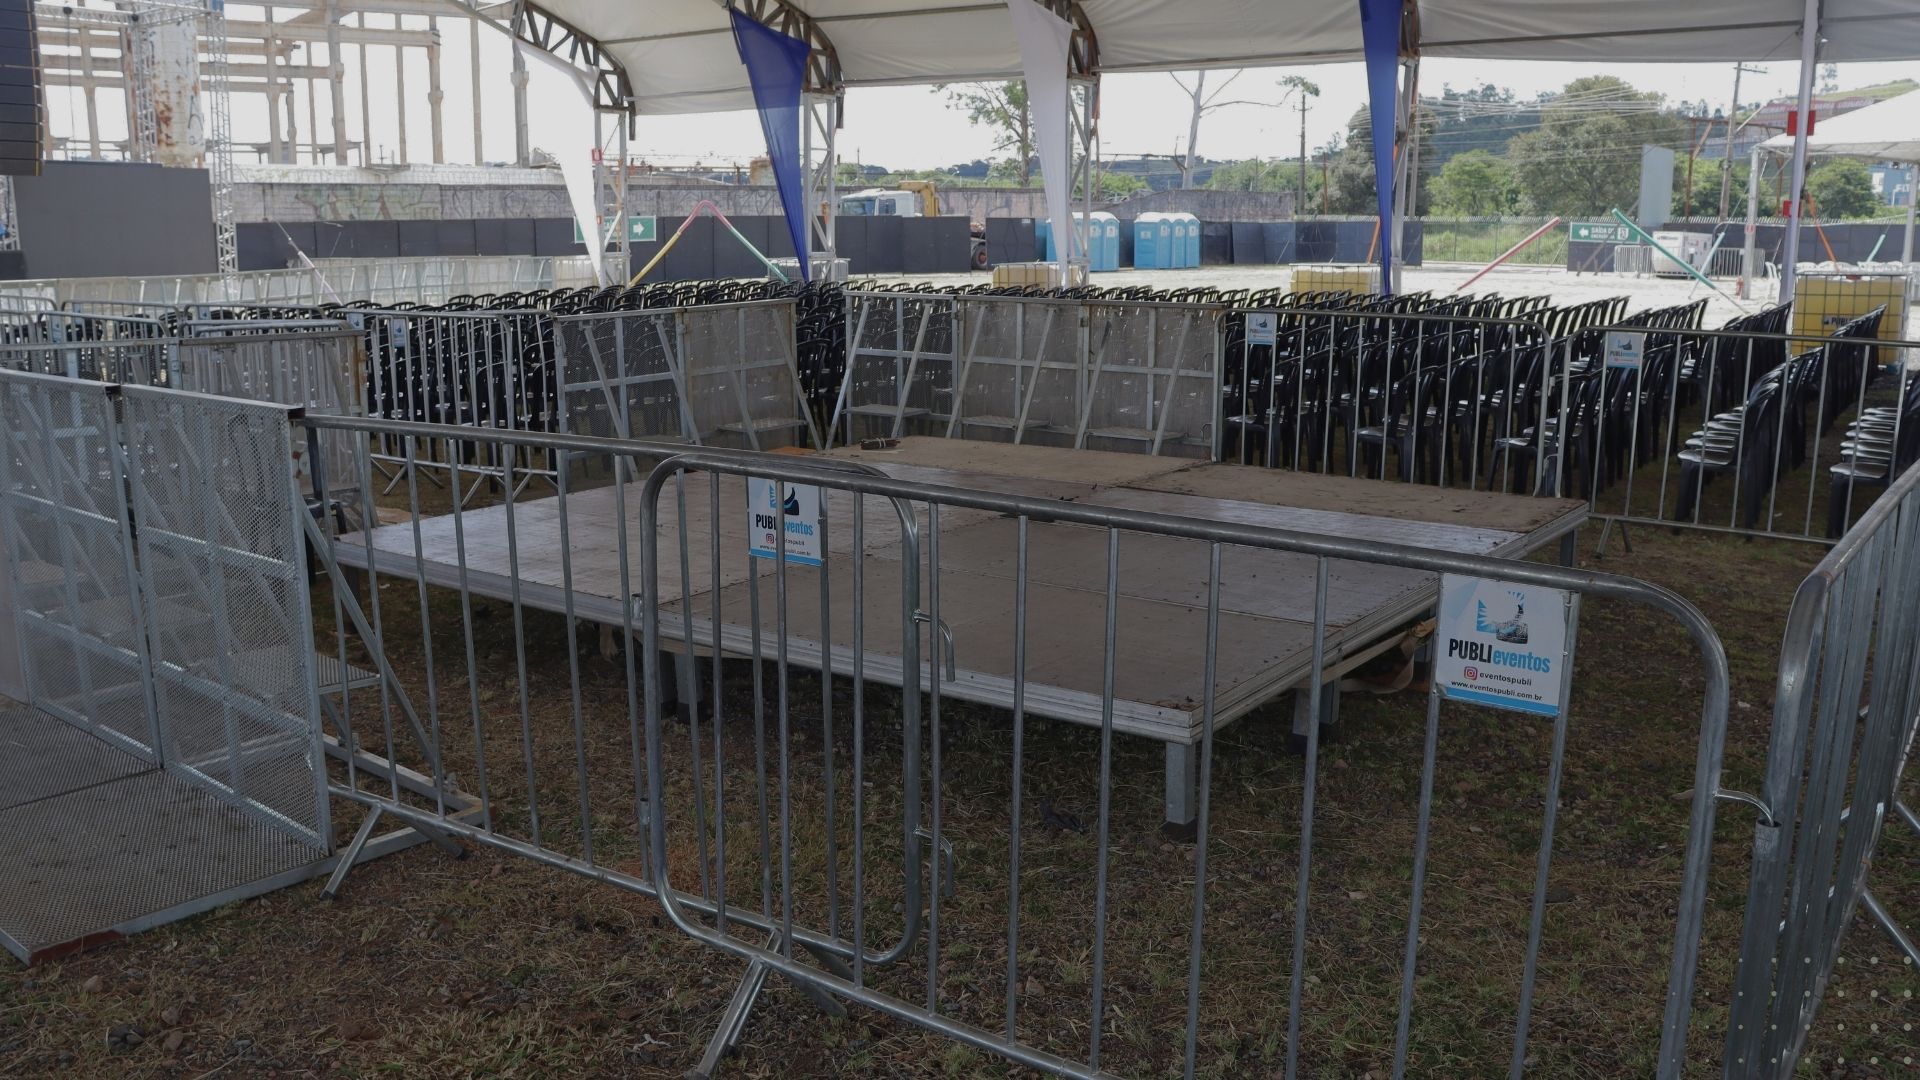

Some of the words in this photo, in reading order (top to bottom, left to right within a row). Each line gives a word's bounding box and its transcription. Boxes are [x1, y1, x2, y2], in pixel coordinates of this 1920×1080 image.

[756, 514, 814, 536] PUBLventos
[1448, 638, 1551, 673] PUBLIeventos
[1479, 672, 1532, 686] eventospubli
[1451, 680, 1543, 701] www.eventospubli.com.br
